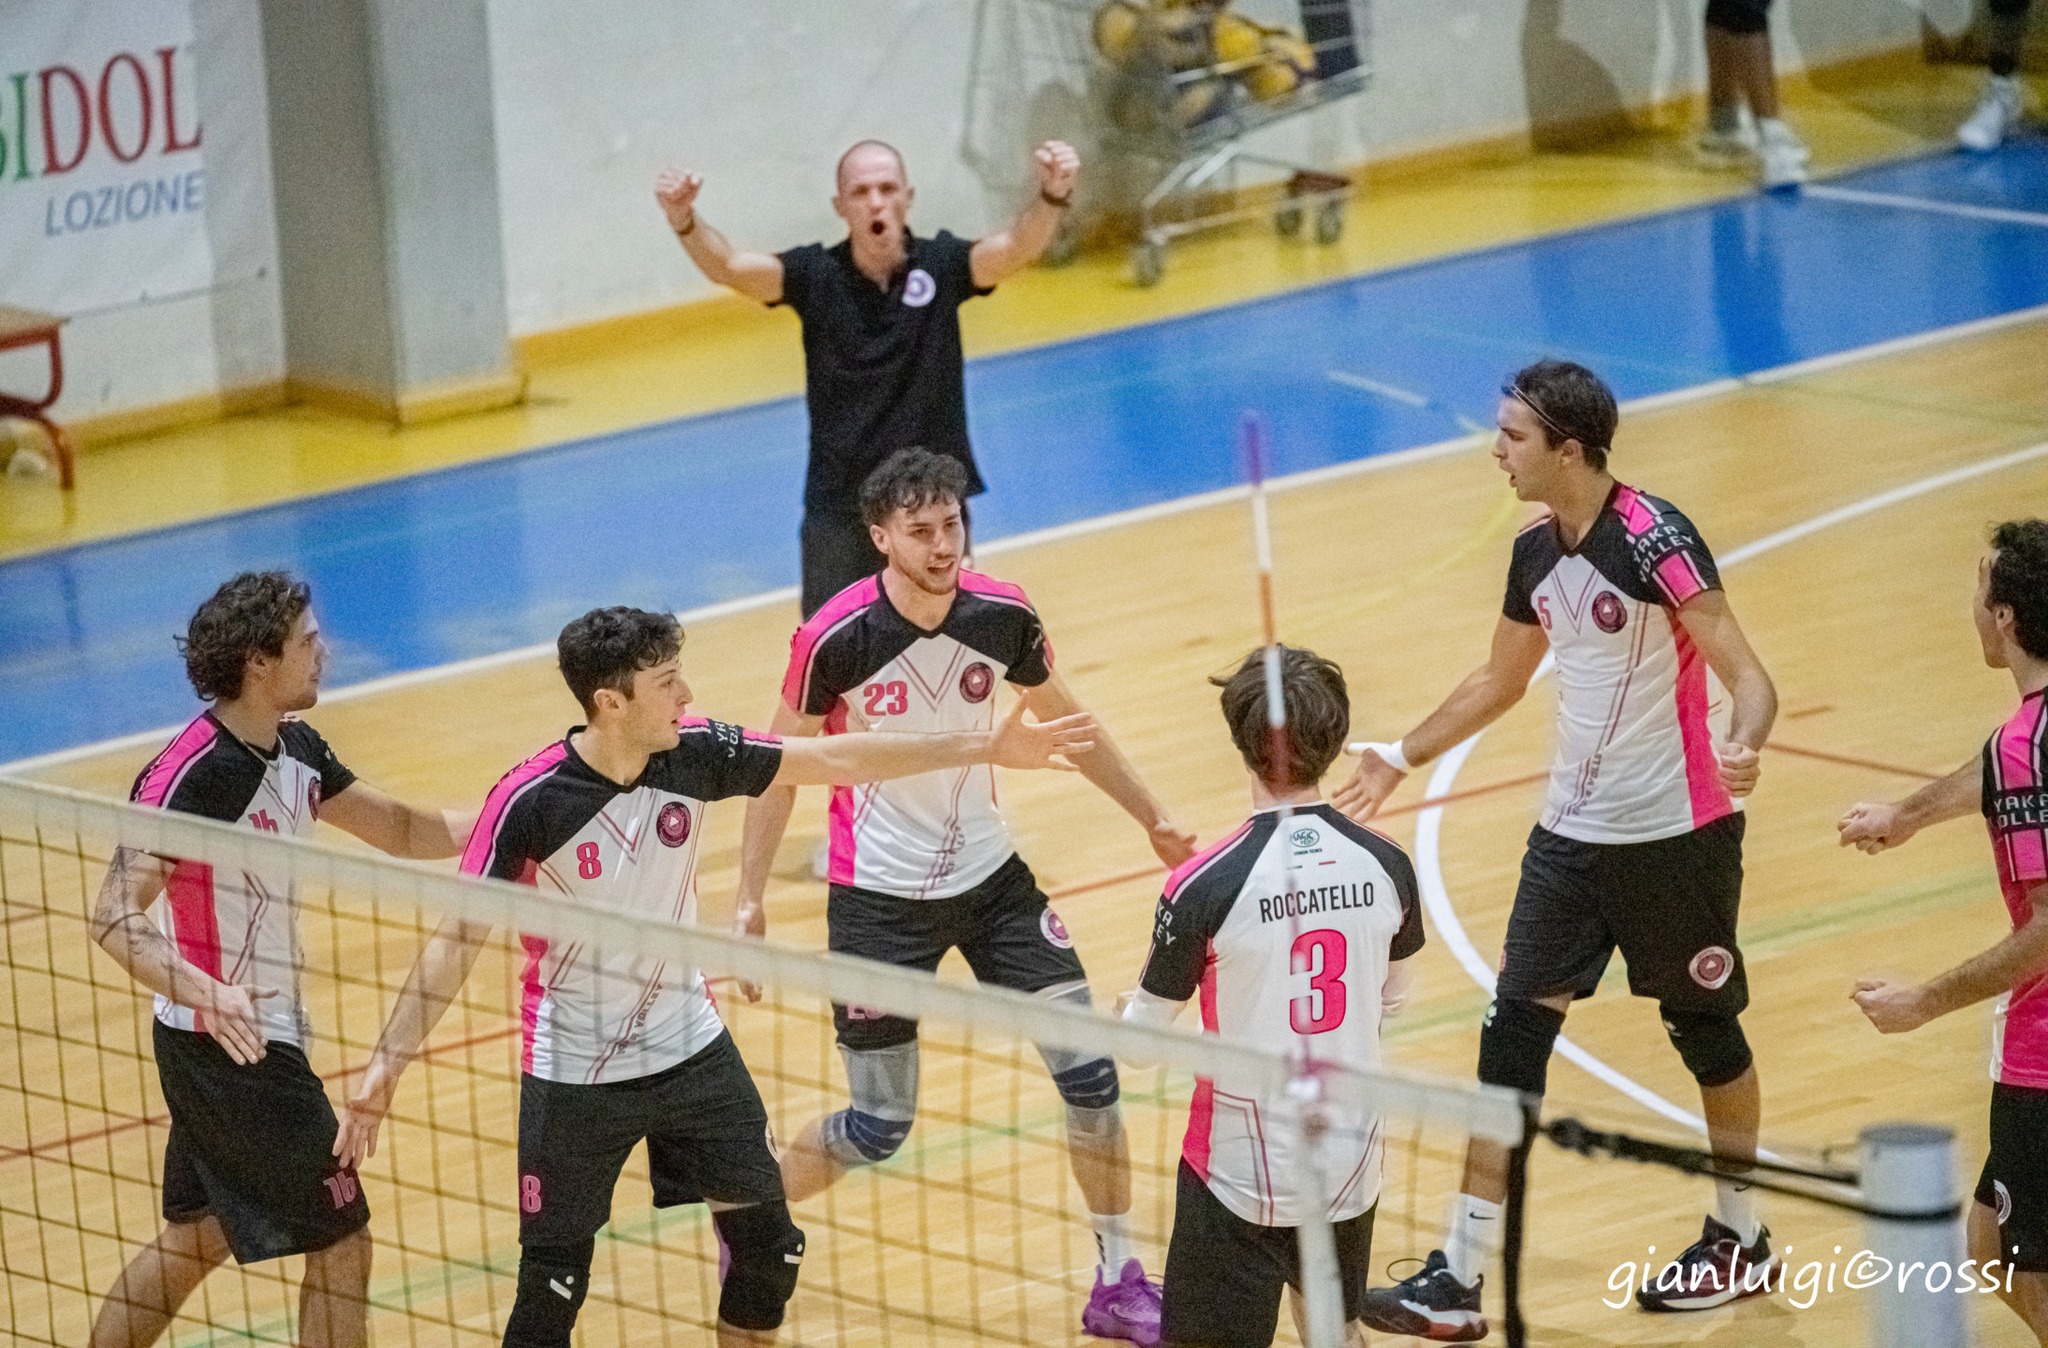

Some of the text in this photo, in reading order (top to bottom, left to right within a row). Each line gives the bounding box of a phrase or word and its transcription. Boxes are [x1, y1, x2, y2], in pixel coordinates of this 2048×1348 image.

[0, 47, 203, 182] IDOL
[45, 169, 206, 238] LOZIONE
[1633, 525, 1679, 563] YAKA
[1639, 535, 1694, 583] VOLLEY
[1538, 595, 1553, 631] 5
[863, 680, 908, 717] 23
[576, 841, 602, 880] 8
[1259, 882, 1374, 924] ROCCATELLO
[1290, 928, 1347, 1035] 3
[322, 1170, 358, 1209] 16
[522, 1174, 542, 1213] 8
